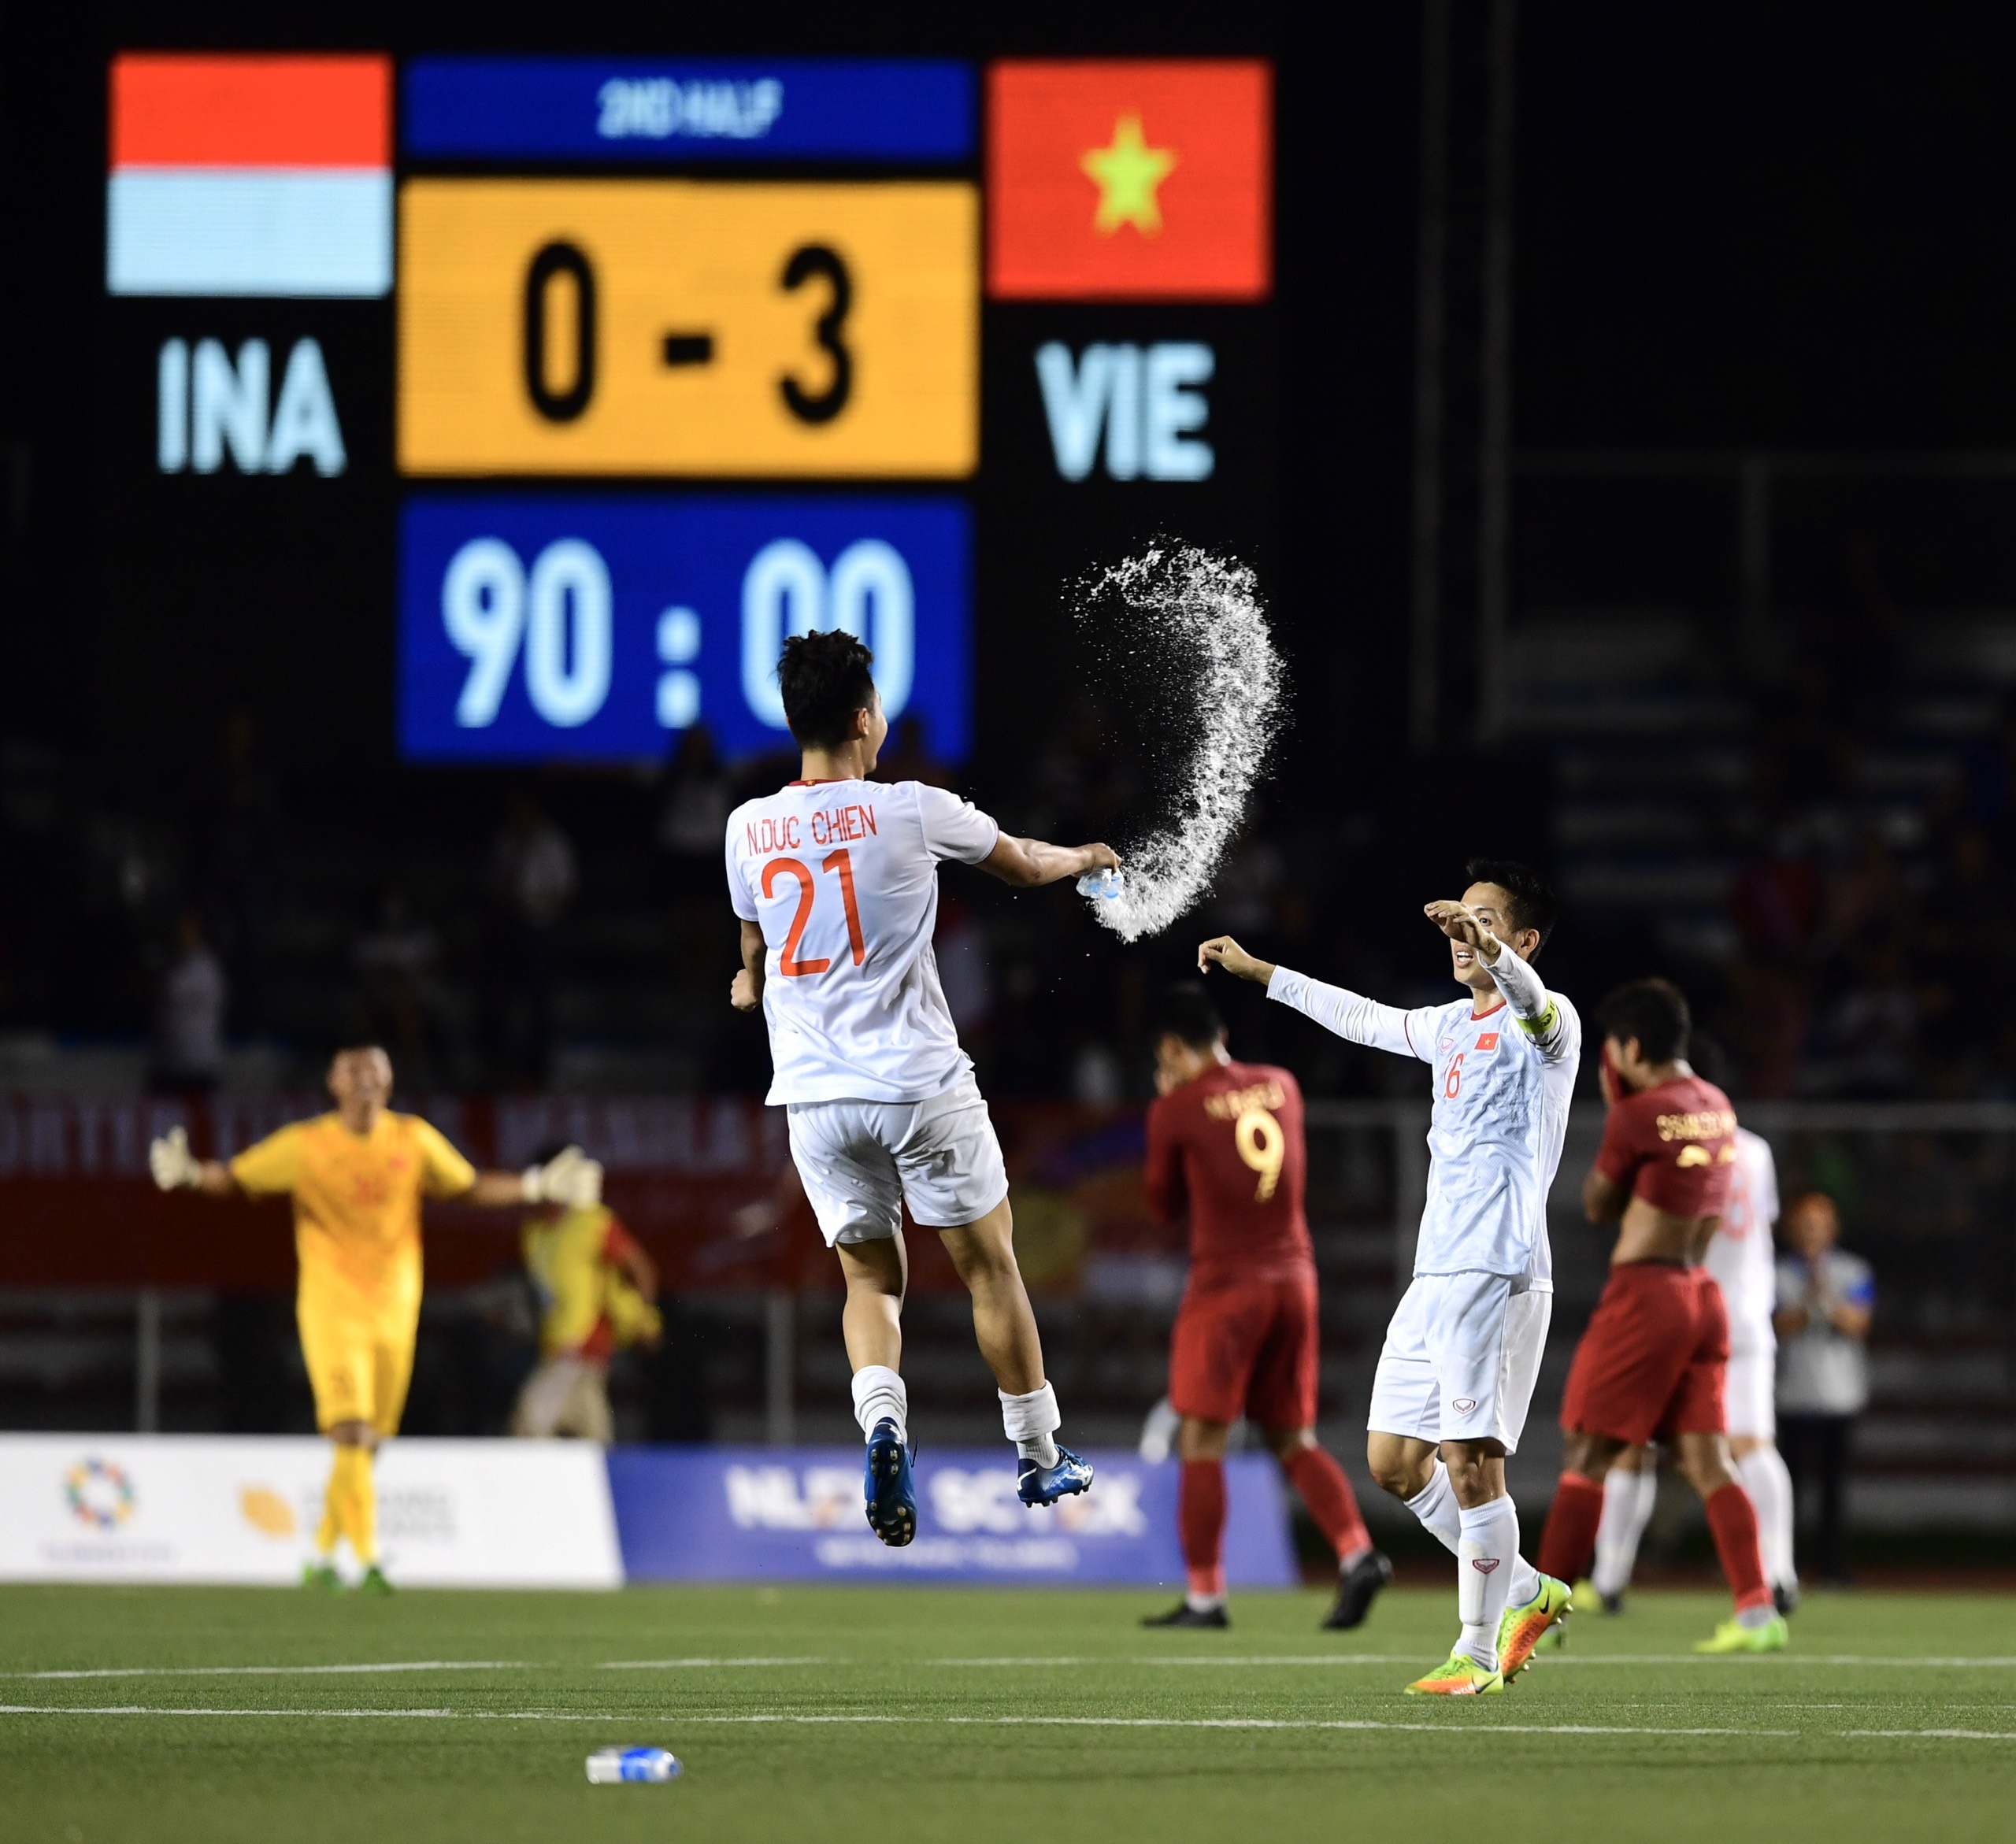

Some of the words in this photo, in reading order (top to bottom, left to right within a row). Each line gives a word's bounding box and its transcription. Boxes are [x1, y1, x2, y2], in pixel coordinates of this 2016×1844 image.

[524, 240, 598, 424] 0
[775, 243, 854, 427] 3
[158, 336, 348, 477] INA
[1036, 341, 1215, 482] VIE
[441, 537, 613, 729] 90
[747, 816, 801, 857] N.DUC
[811, 804, 878, 845] CHIEN
[761, 848, 865, 977] 21
[1235, 1107, 1285, 1202] 9
